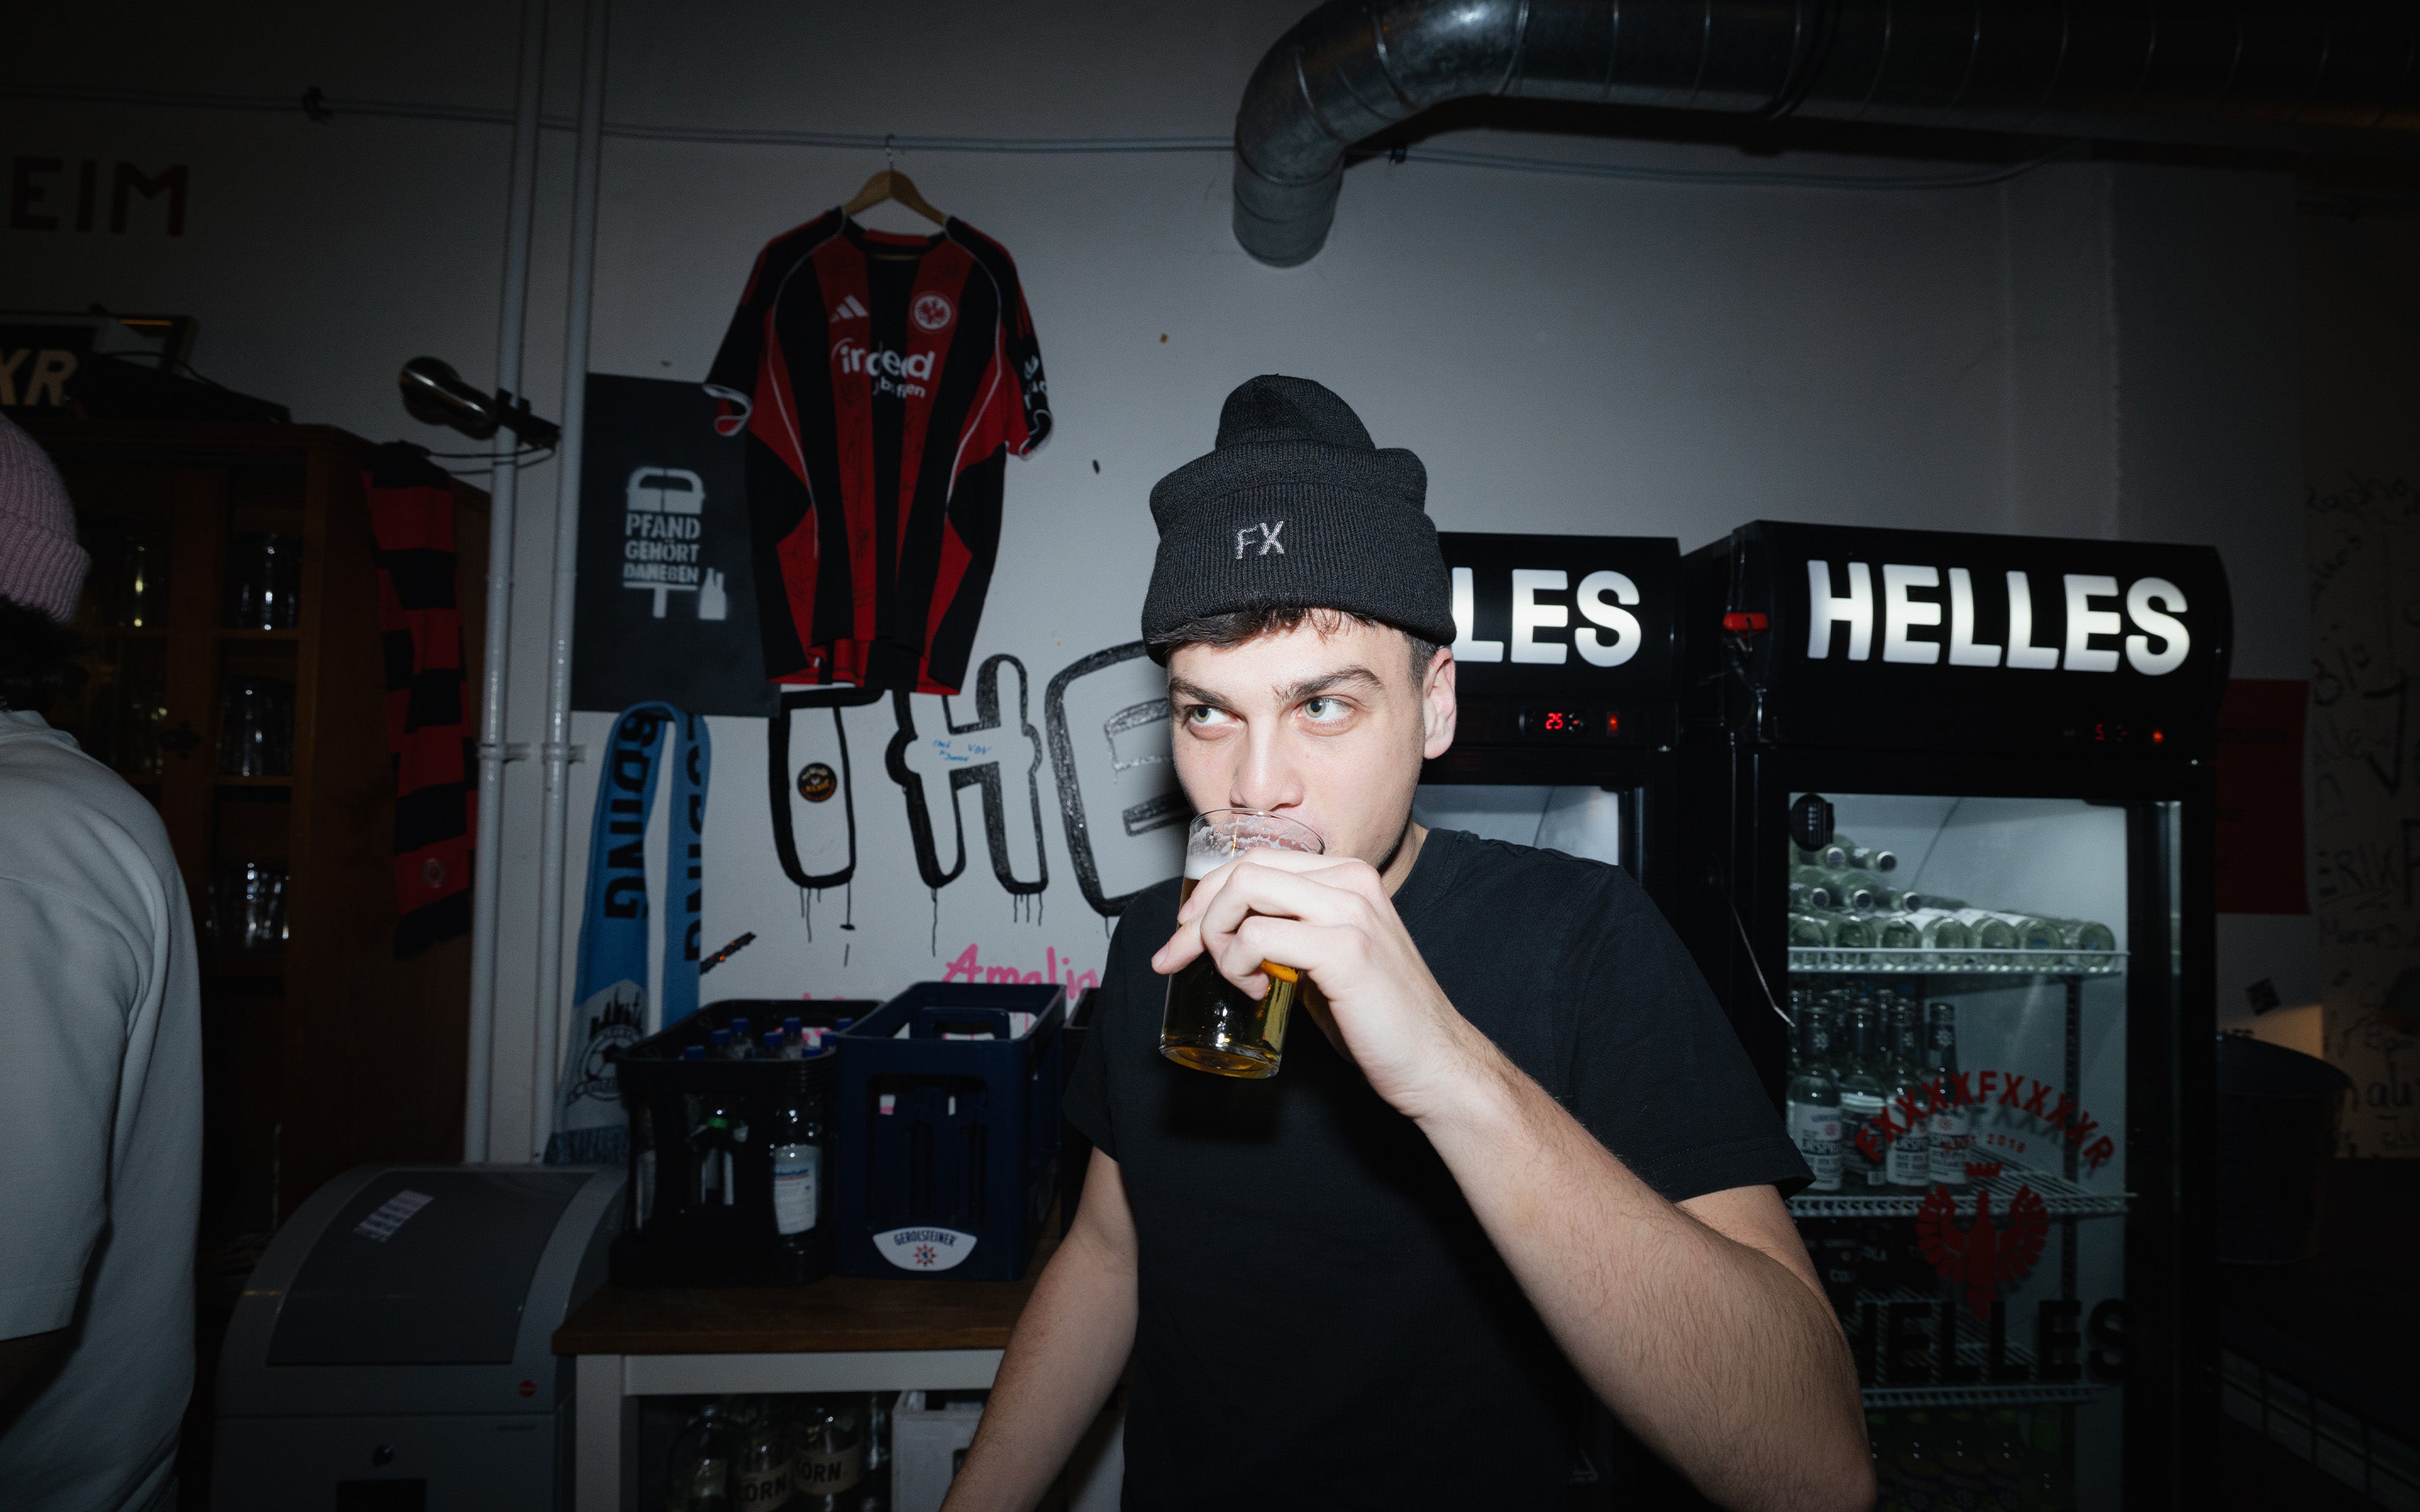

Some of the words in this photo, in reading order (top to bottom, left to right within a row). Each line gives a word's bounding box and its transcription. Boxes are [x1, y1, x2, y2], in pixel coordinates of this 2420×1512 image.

[11, 156, 188, 237] EIM
[625, 513, 701, 540] PFAND
[1236, 520, 1284, 559] FX
[625, 538, 700, 562] GEHÖRT
[1451, 567, 1642, 667] LES
[1807, 559, 2190, 675] HELLES
[1544, 711, 1565, 731] 25
[894, 1230, 956, 1246] GEROLSTEINER
[797, 1462, 842, 1482] ORN
[743, 1476, 786, 1502] ORN
